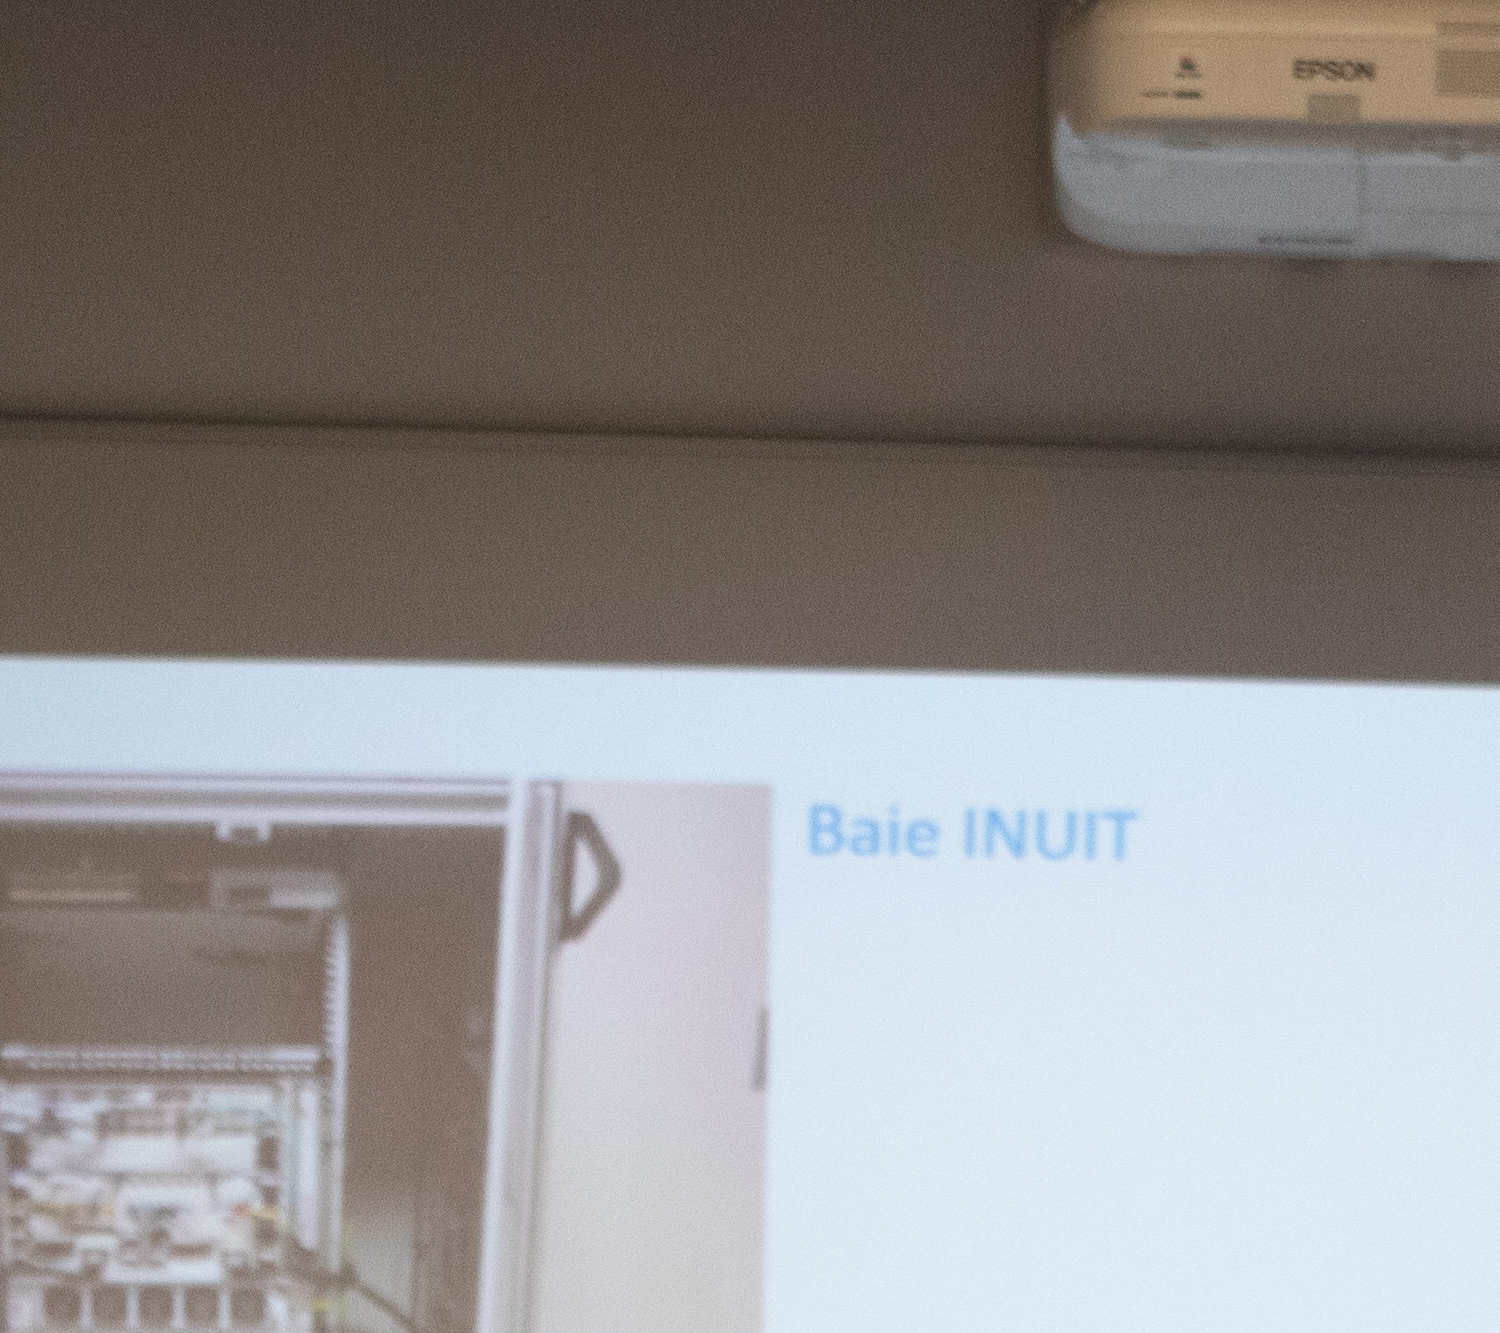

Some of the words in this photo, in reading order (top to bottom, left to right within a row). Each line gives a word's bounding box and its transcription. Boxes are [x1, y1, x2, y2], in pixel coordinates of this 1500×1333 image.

[1292, 57, 1377, 82] EPSON
[808, 802, 940, 857] Baie
[964, 805, 1139, 862] INUIT
